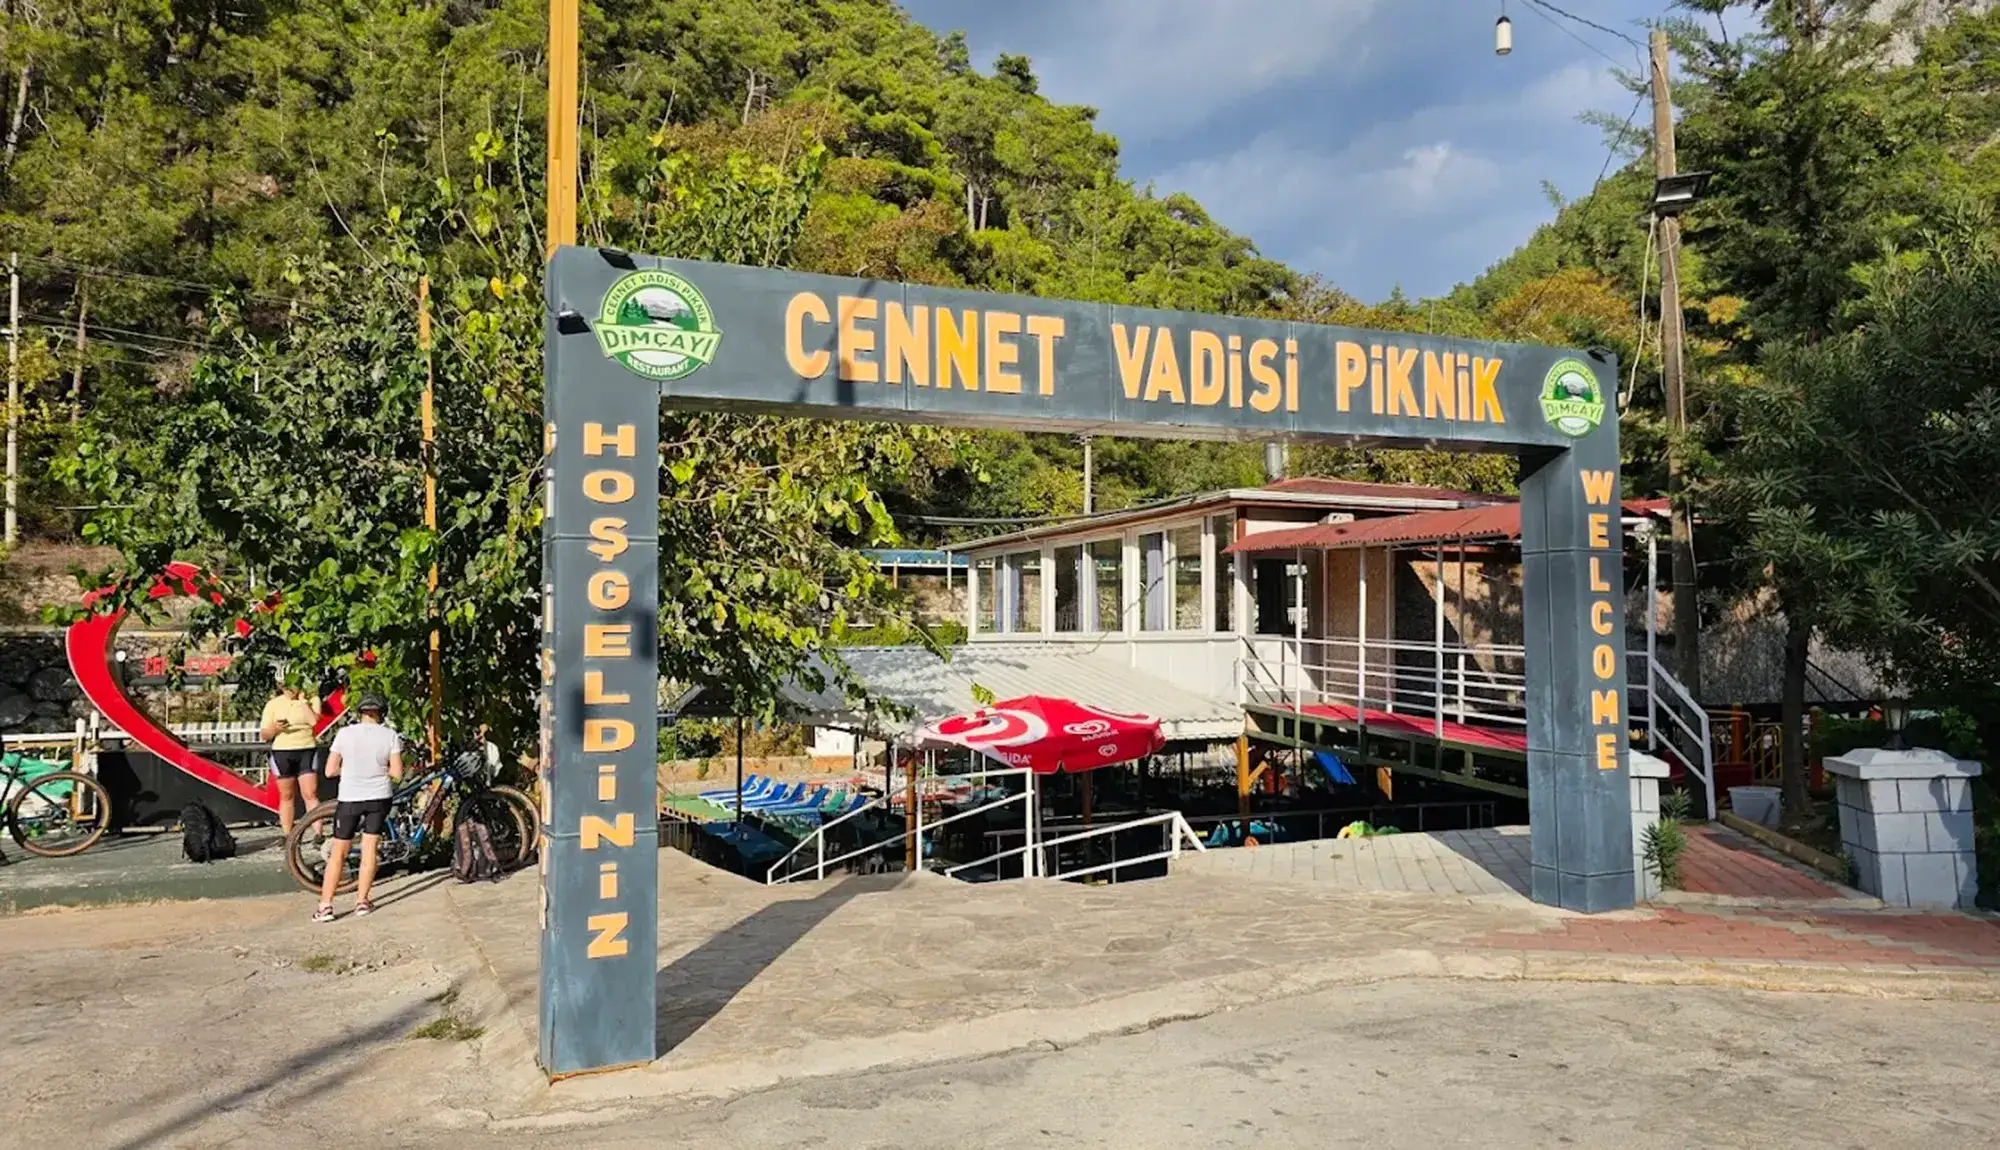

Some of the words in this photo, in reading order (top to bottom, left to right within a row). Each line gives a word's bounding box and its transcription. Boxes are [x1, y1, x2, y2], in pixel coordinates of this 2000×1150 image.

[628, 355, 690, 376] RESTAURANT
[785, 291, 1065, 396] CENNET
[1580, 469, 1618, 771] WELCOME
